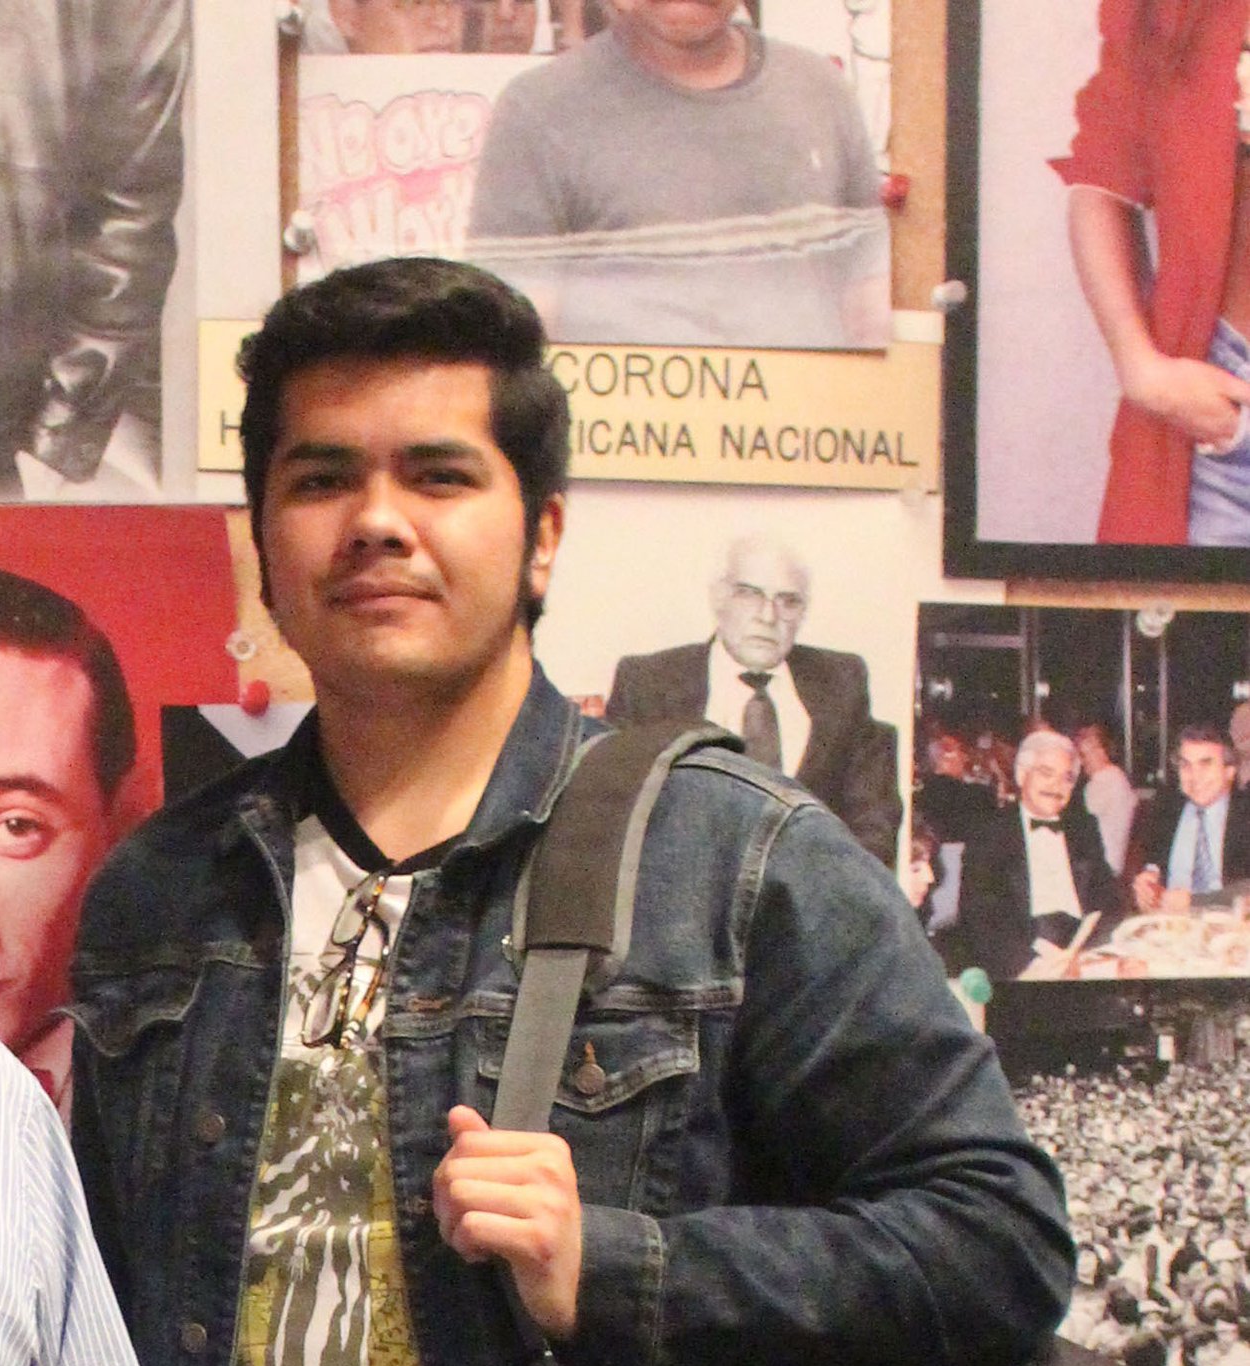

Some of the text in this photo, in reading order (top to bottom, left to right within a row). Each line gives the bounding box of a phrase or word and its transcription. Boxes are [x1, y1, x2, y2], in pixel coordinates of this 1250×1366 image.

[551, 351, 768, 400] CORONA
[577, 419, 919, 467] ICANA NACIONAL
